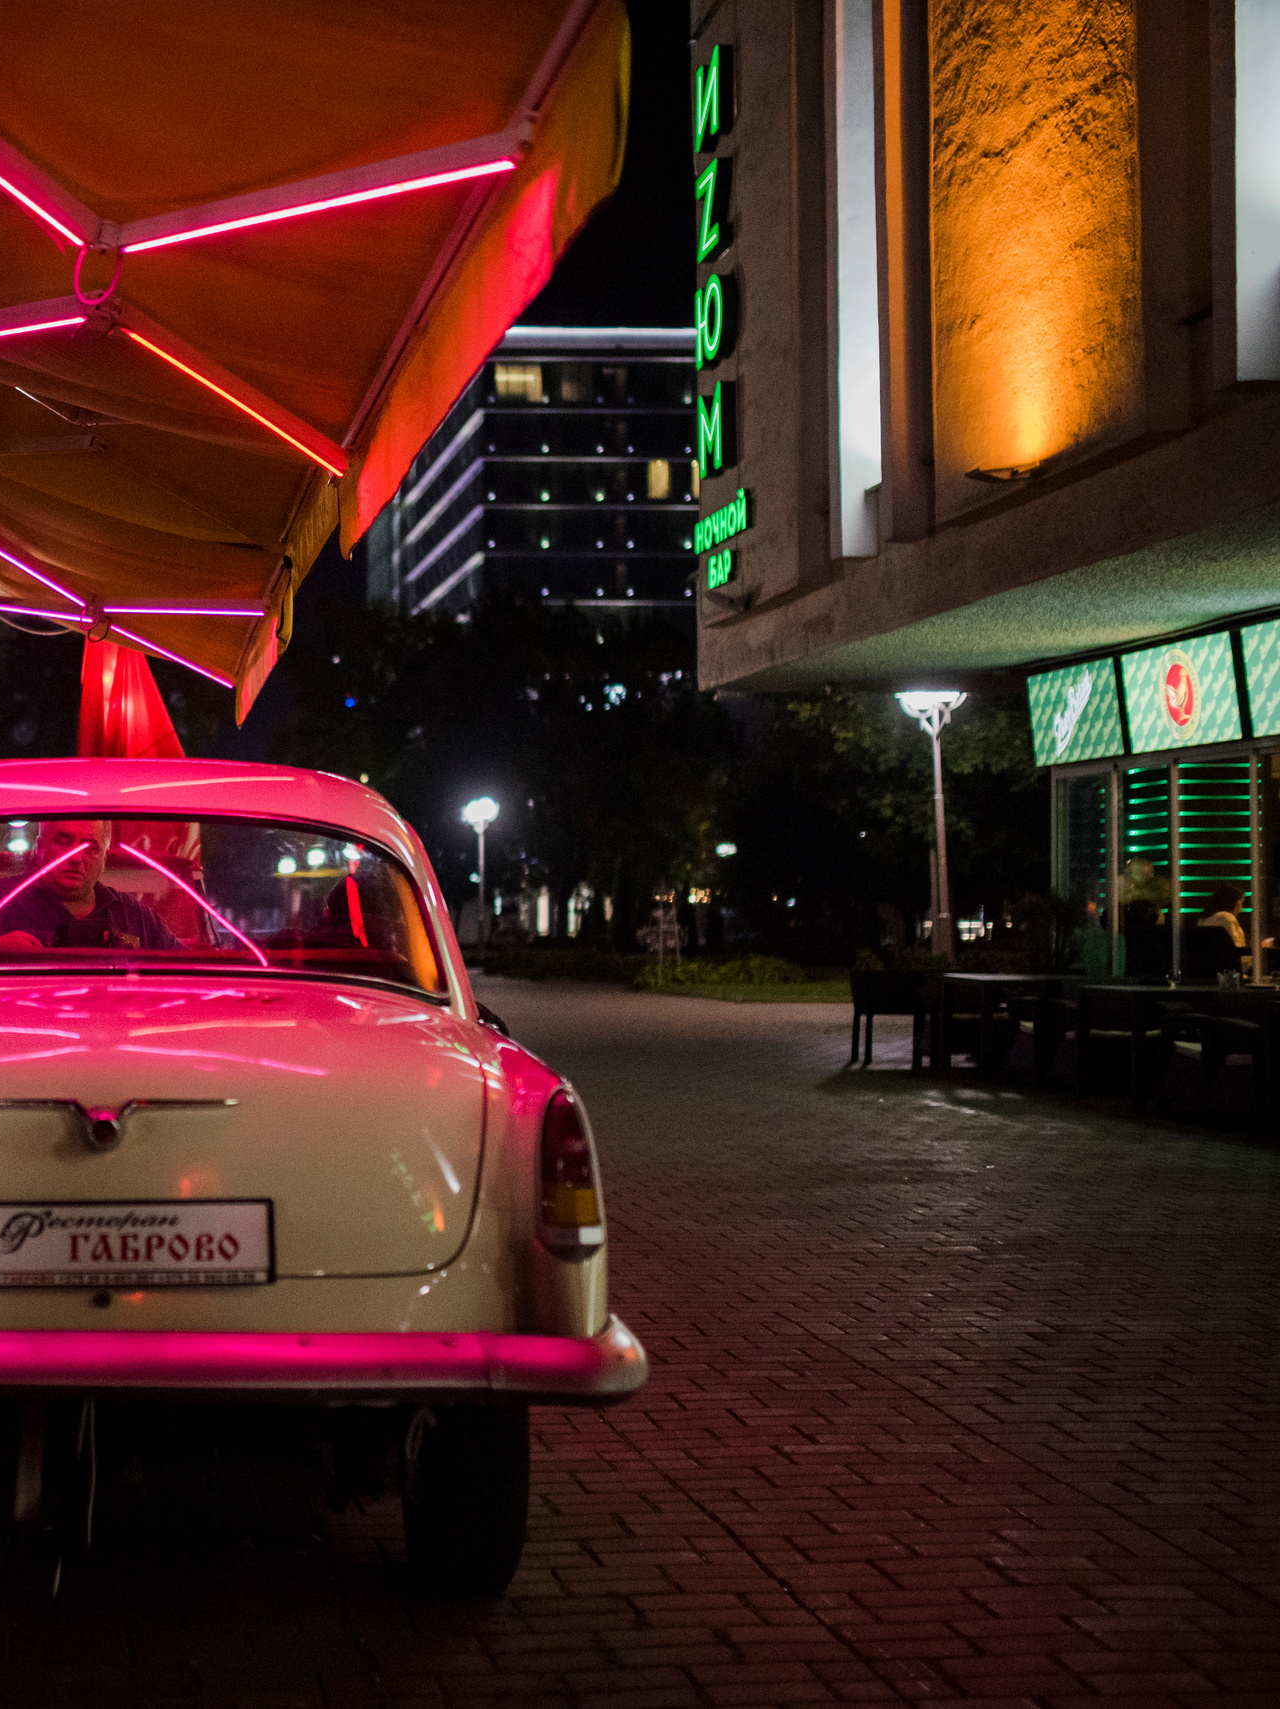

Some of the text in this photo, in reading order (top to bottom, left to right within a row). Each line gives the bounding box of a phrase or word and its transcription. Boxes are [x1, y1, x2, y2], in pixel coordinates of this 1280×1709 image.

[694, 488, 746, 555] НОЧНОЙ
[708, 548, 731, 589] БАР
[69, 1232, 241, 1263] ГАБРОВО
